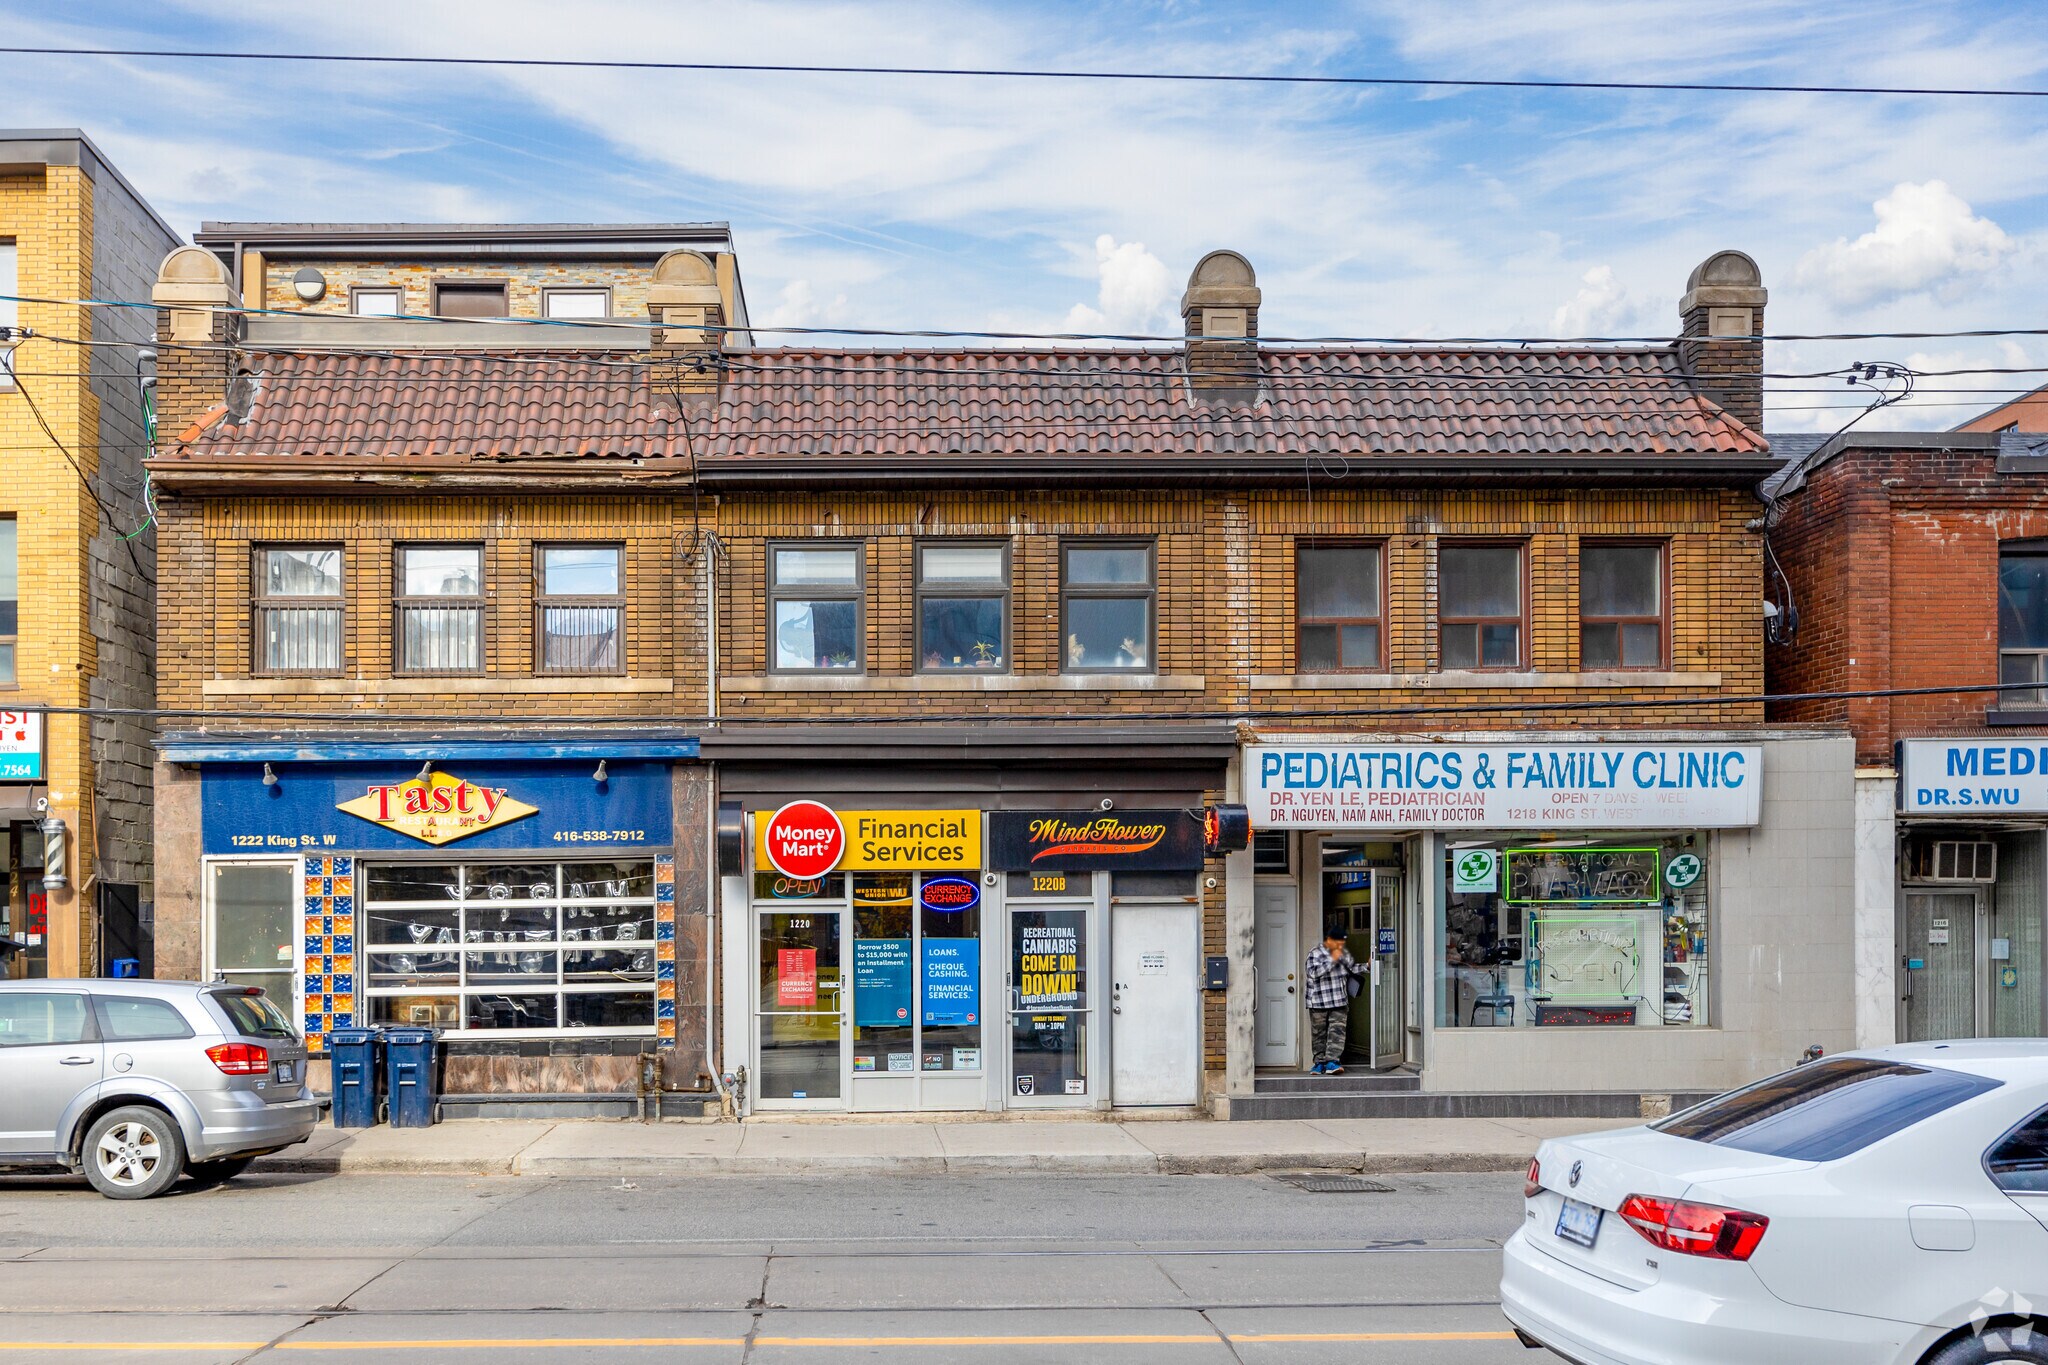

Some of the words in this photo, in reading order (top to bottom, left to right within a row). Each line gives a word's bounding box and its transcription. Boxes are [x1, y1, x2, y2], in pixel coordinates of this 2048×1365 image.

[0, 764, 31, 776] .7564
[1261, 751, 1463, 790] PEDIATRICS
[1472, 752, 1497, 789] &
[1506, 751, 1625, 789] FAMILY
[1632, 750, 1746, 790] CLINIC
[367, 779, 507, 824] Tasty
[1270, 791, 1298, 806] DR.
[1300, 791, 1334, 806] YEN
[1340, 791, 1364, 808] LE,
[1368, 791, 1486, 806] PEDIATRICIAN
[1551, 792, 1589, 804] OPEN
[1592, 793, 1600, 804] 7
[1603, 792, 1639, 804] DAYS
[1917, 788, 2020, 806] DR.S.WU
[1270, 808, 1288, 822] DR.
[1292, 808, 1339, 823] NGUYEN,
[1342, 808, 1366, 822] NAM
[1370, 808, 1396, 823] ANH,
[1399, 808, 1439, 822] FAMILY
[1441, 807, 1485, 822] DOCTOR
[1506, 808, 1537, 819] 1218
[1541, 808, 1576, 819] KING
[1603, 807, 1642, 819] WEST
[400, 816, 475, 827] RESTAURANT
[858, 818, 967, 838] Financial
[231, 835, 264, 846] 1222
[267, 835, 297, 848] King
[300, 835, 320, 846] St.
[323, 834, 337, 846] W
[553, 830, 645, 842] 416-538-7912
[775, 825, 836, 844] Money
[862, 841, 964, 861] Services
[773, 877, 822, 895] OPEN
[924, 885, 972, 894] CURRENCY
[1032, 877, 1066, 891] 1220B
[1512, 870, 1654, 898] PHARMACY
[924, 894, 972, 903] EXCHANGE
[790, 919, 810, 929] 1220
[1023, 927, 1076, 938] RECREATIONAL
[1379, 931, 1396, 942] OPEN
[928, 948, 960, 956] LOANS.
[1022, 939, 1077, 954] CANNABIS
[1021, 954, 1057, 972] COME
[1060, 954, 1076, 972] ON
[928, 970, 970, 978] CASHING.
[928, 984, 974, 992] FINANCIAL
[1021, 973, 1077, 996] DOWN!
[1020, 991, 1078, 1004] UNDERGROUND
